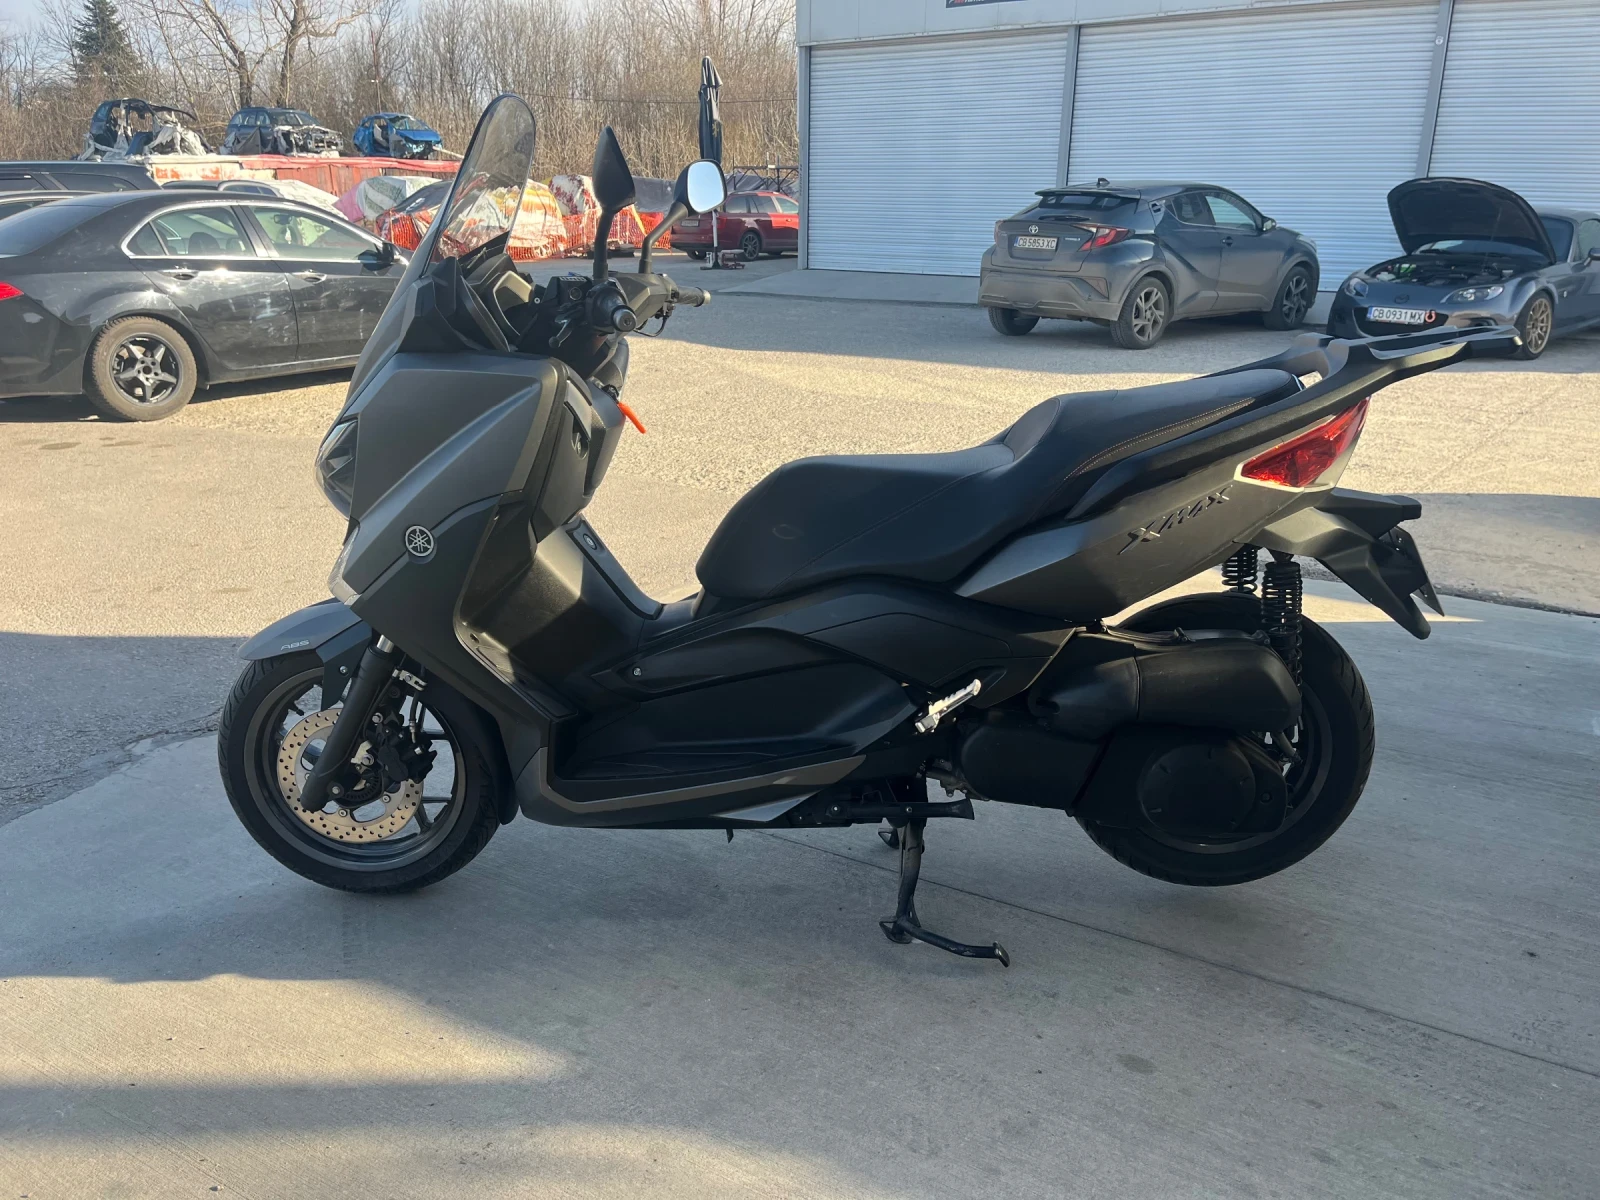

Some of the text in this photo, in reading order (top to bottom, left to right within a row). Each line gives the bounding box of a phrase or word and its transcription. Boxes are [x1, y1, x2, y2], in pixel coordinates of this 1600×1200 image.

[1018, 237, 1027, 247] CB
[1046, 239, 1056, 249] XC
[1372, 308, 1424, 322] CB 0931 MX
[280, 639, 310, 651] ABS
